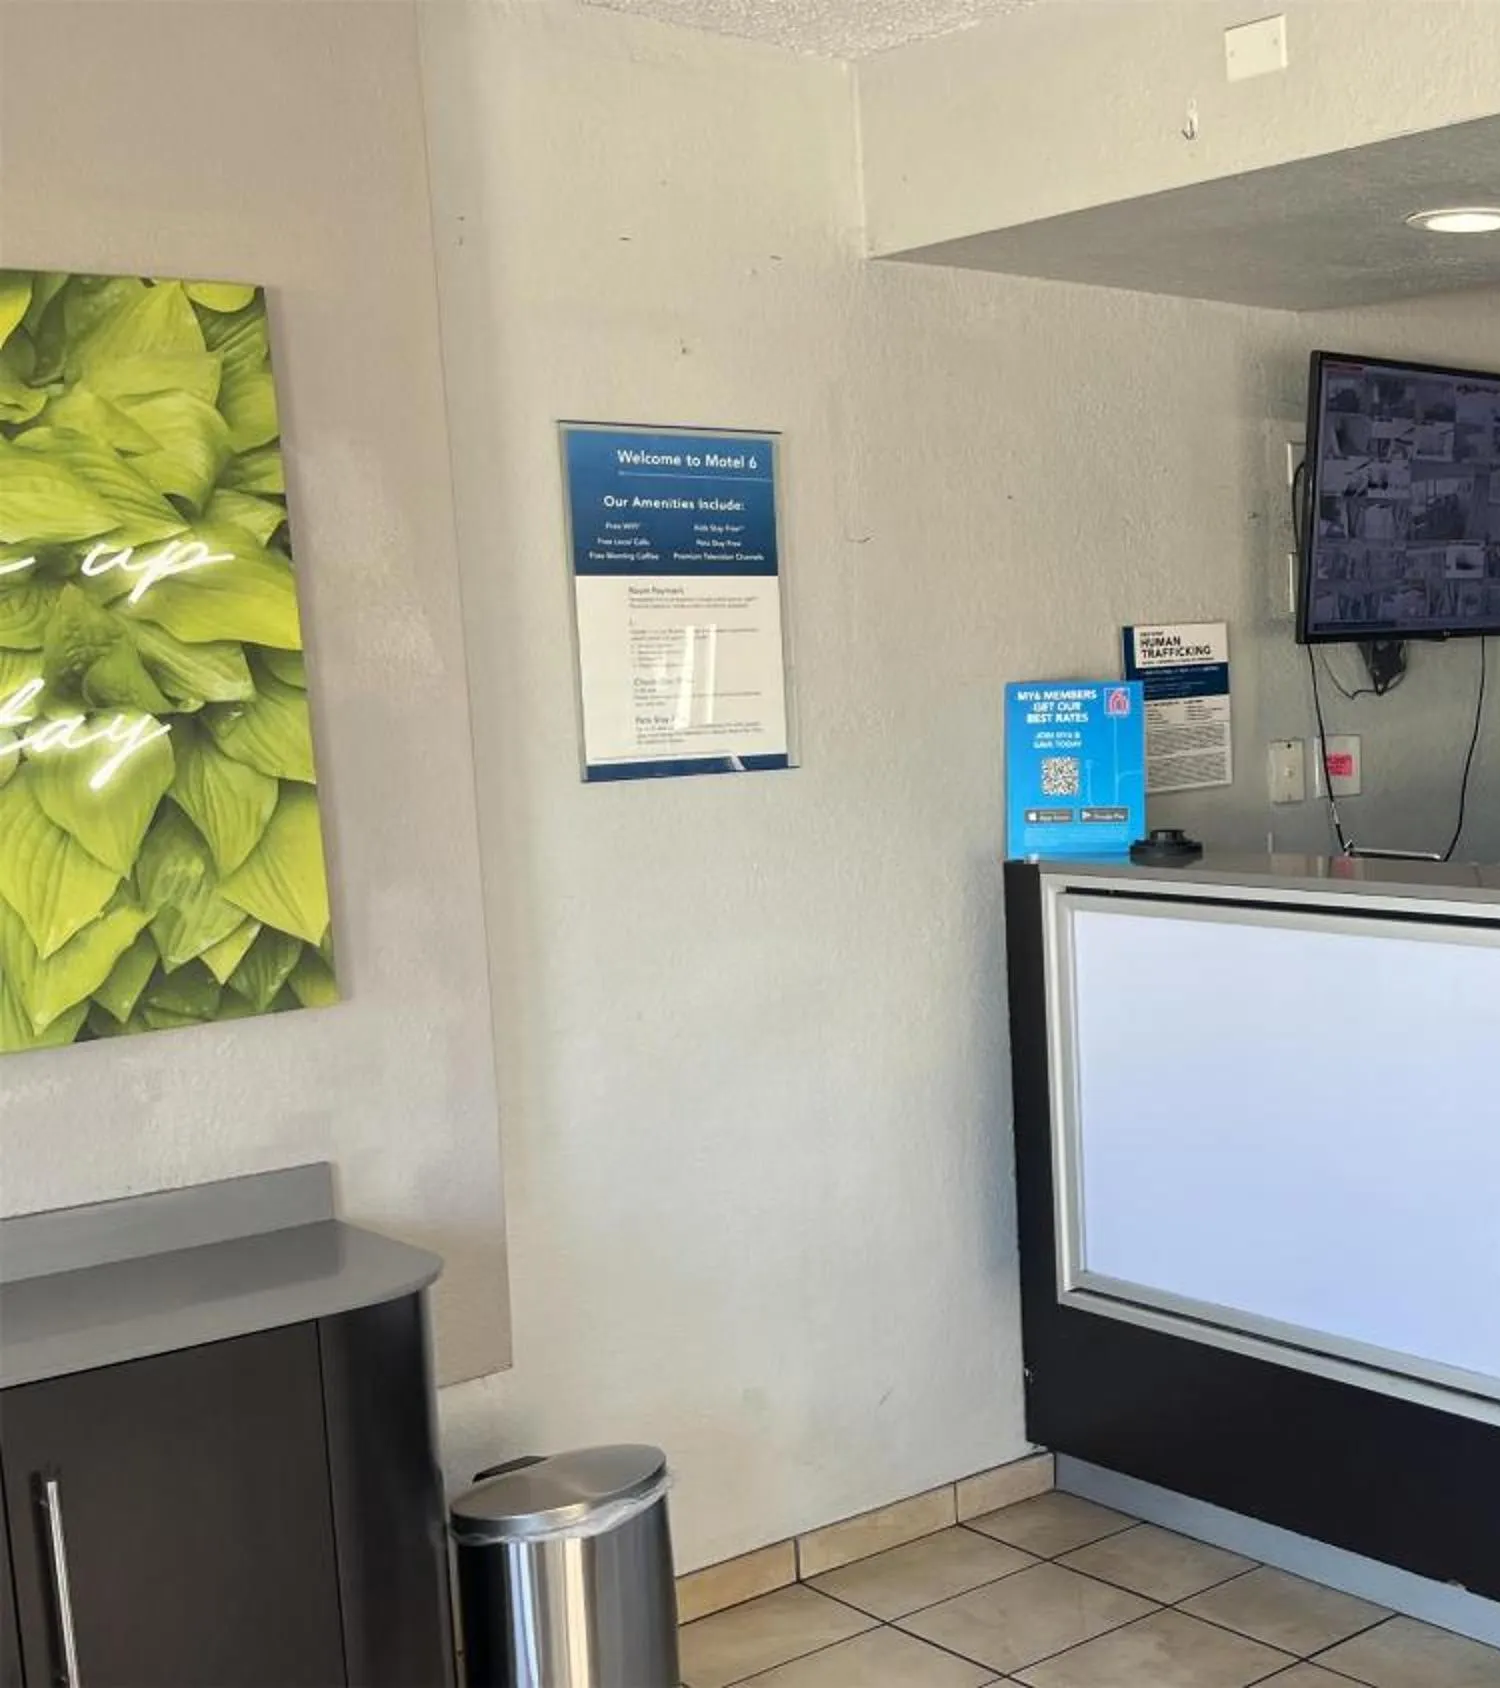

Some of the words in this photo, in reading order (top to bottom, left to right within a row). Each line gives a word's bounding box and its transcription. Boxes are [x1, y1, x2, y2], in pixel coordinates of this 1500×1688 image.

[617, 449, 681, 467] Welcome
[687, 453, 701, 467] to
[705, 453, 745, 469] Motel
[748, 455, 758, 470] 6
[603, 495, 628, 508] Our
[632, 496, 695, 510] Amenities
[699, 498, 745, 511] Include:
[635, 551, 659, 561] Coffee
[1140, 636, 1181, 648] HUMAN
[1141, 645, 1211, 658] TRAFFICKING
[1043, 689, 1097, 701] MEMBERS
[1033, 701, 1055, 712] GET
[1057, 701, 1082, 711] OUR
[1026, 713, 1054, 724] BEST
[1055, 713, 1089, 723] RATES
